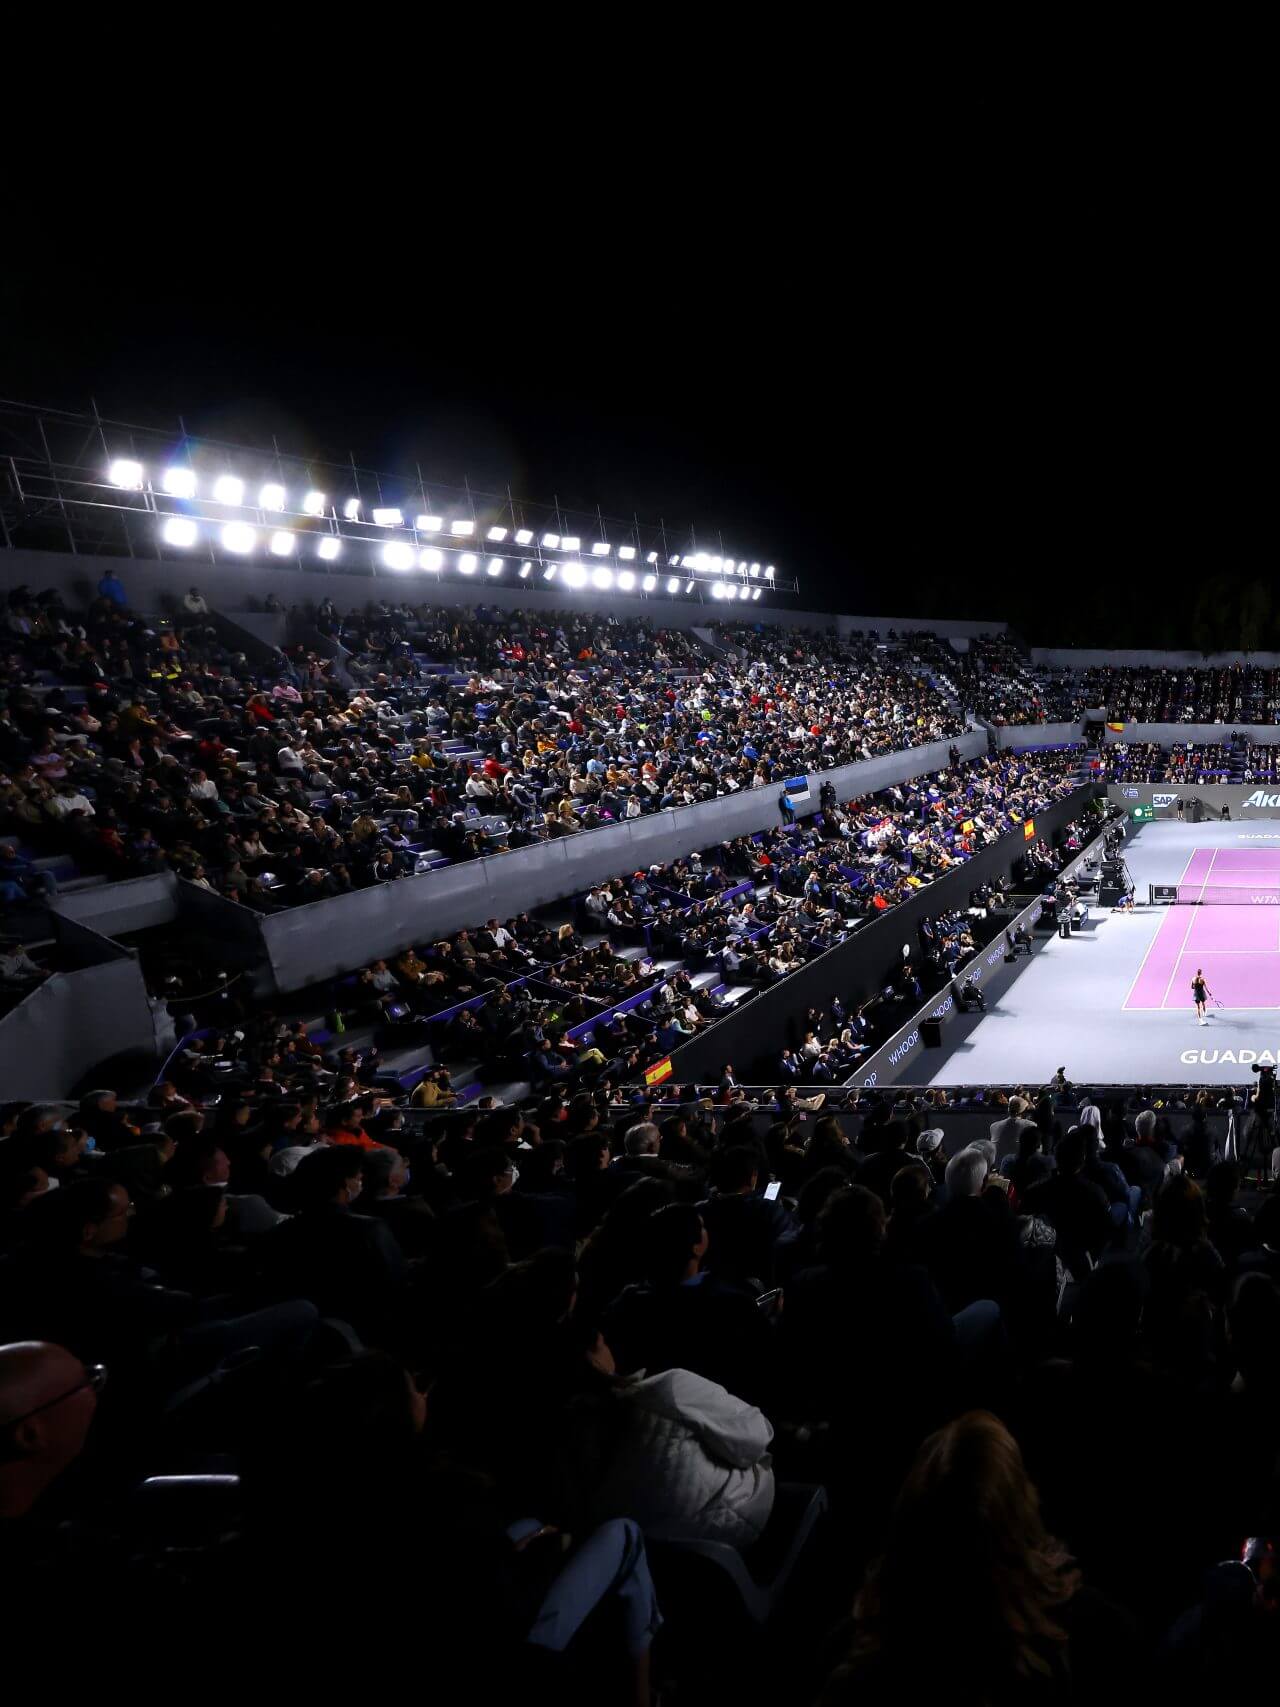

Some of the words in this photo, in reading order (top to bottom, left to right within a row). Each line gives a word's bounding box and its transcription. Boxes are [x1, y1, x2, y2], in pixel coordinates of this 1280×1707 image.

[1153, 796, 1173, 805] SAP
[1250, 895, 1279, 904] WTA
[888, 1030, 919, 1066] WHOOP
